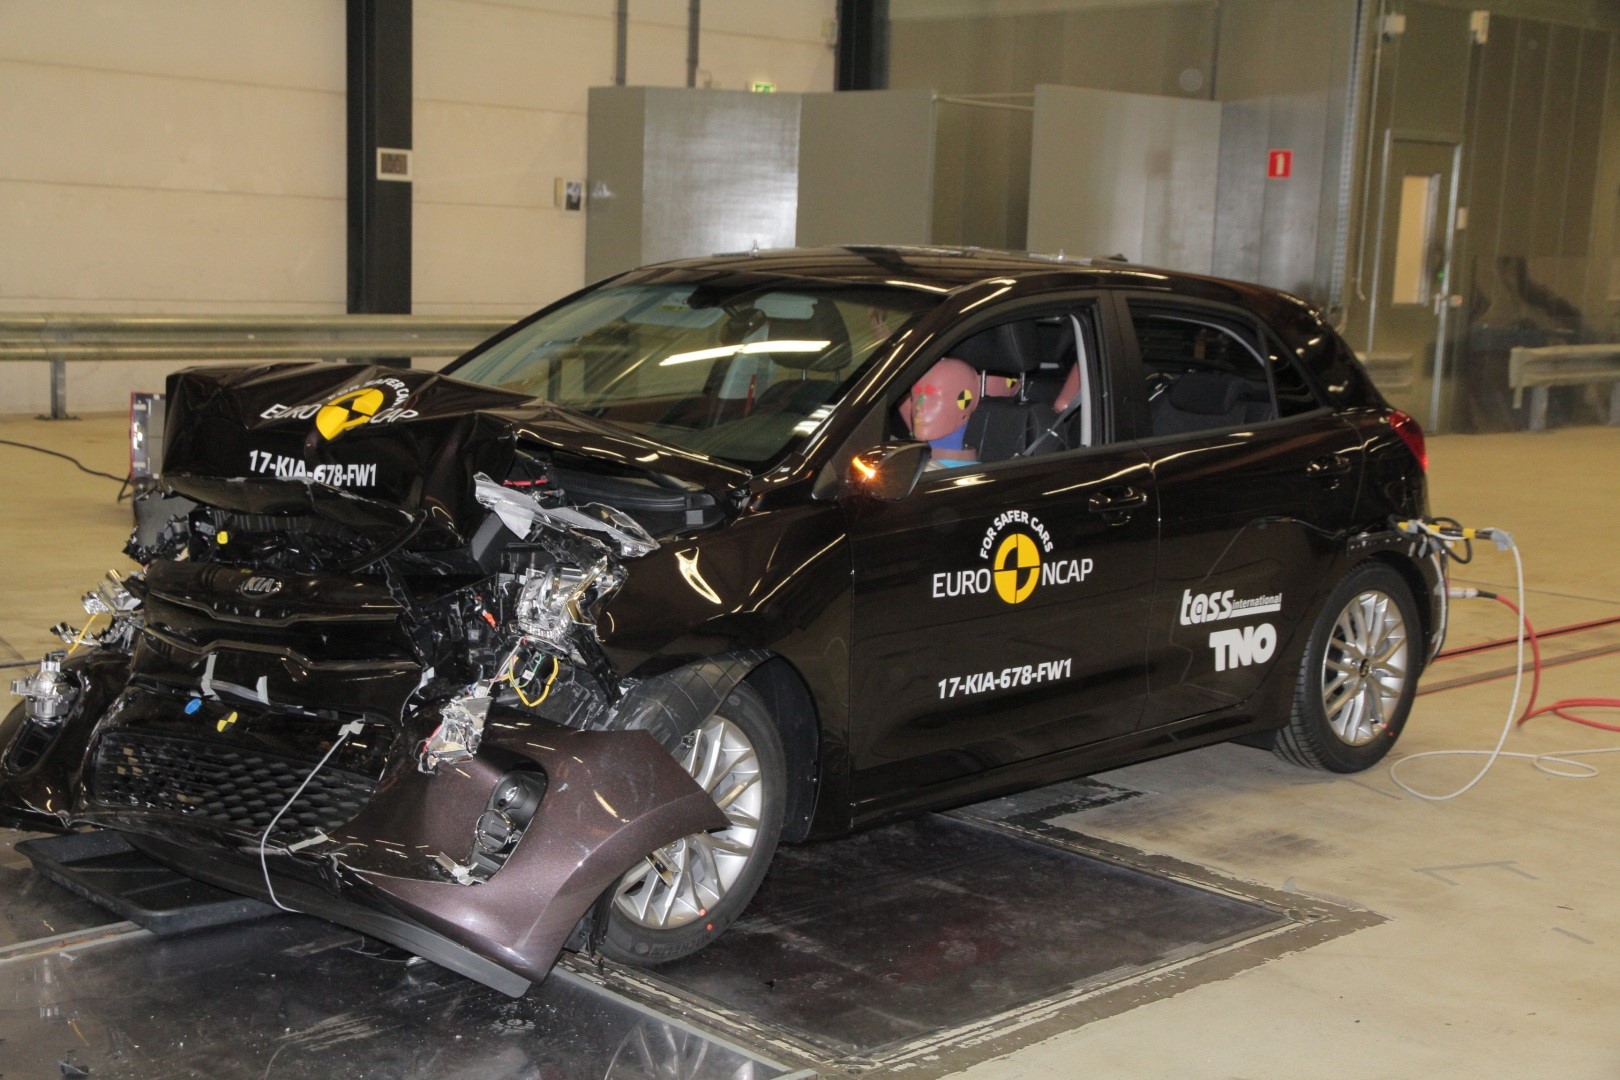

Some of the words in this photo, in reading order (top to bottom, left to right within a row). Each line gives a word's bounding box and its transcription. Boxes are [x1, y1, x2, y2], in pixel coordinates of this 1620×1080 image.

[364, 378, 405, 390] SAFER
[391, 388, 410, 408] CA
[260, 403, 324, 420] EURO
[366, 408, 419, 424] CAP
[249, 449, 377, 487] 17-KIA-678-FW1
[979, 526, 998, 560] FOR
[993, 509, 1029, 531] SAFER
[1030, 517, 1054, 553] CARS
[244, 576, 276, 593] KIA
[932, 568, 991, 599] EURO
[1042, 558, 1094, 587] NCAP
[1180, 588, 1235, 626] tass
[1232, 592, 1283, 610] international
[1208, 622, 1278, 672] TNO
[937, 657, 1073, 700] 17-KIA-678-FW1
